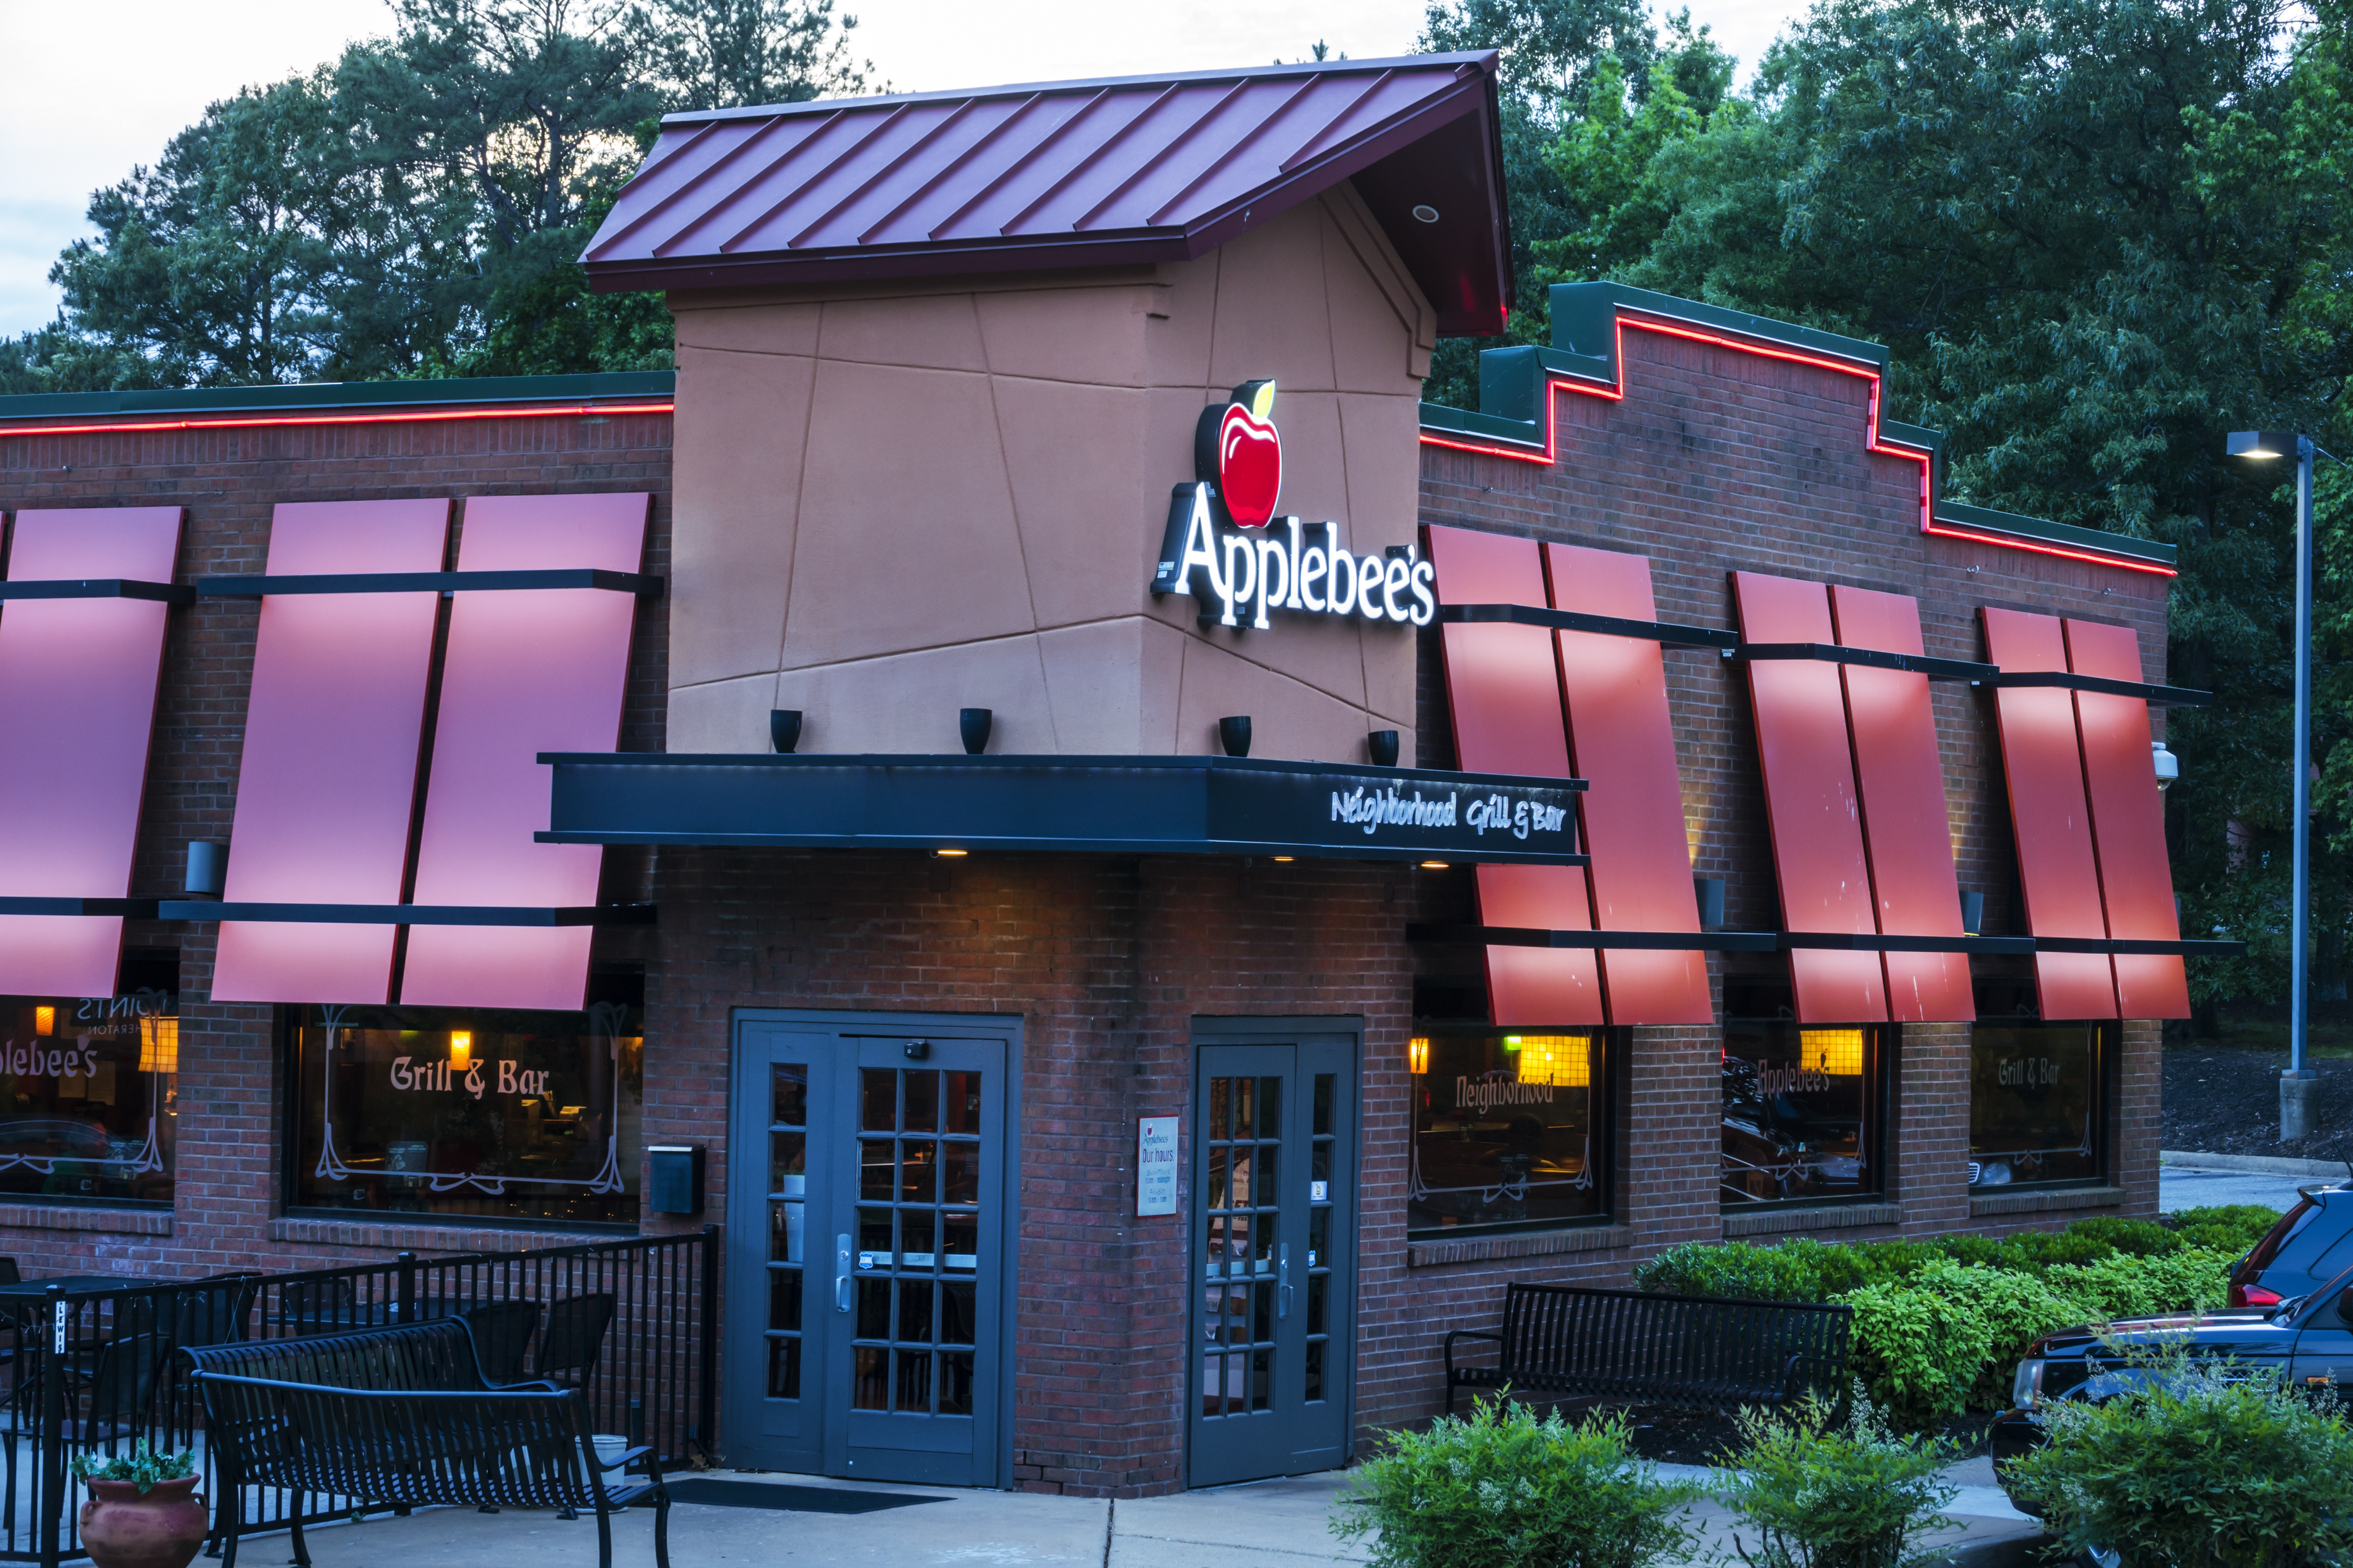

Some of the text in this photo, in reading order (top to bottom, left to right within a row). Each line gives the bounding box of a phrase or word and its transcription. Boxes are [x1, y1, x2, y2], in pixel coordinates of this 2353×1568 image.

[1173, 481, 1435, 630] Applebee's
[1331, 786, 1567, 839] Neighborhood Grill & Bar
[389, 1055, 550, 1100] Grill & Bar
[1456, 1072, 1554, 1114] Neighborhood
[1757, 1057, 1830, 1101] Applebee's
[1998, 1057, 2060, 1089] Grill & Bar
[1142, 1148, 1175, 1163] Our hours.
[1143, 1133, 1168, 1146] Applebee's
